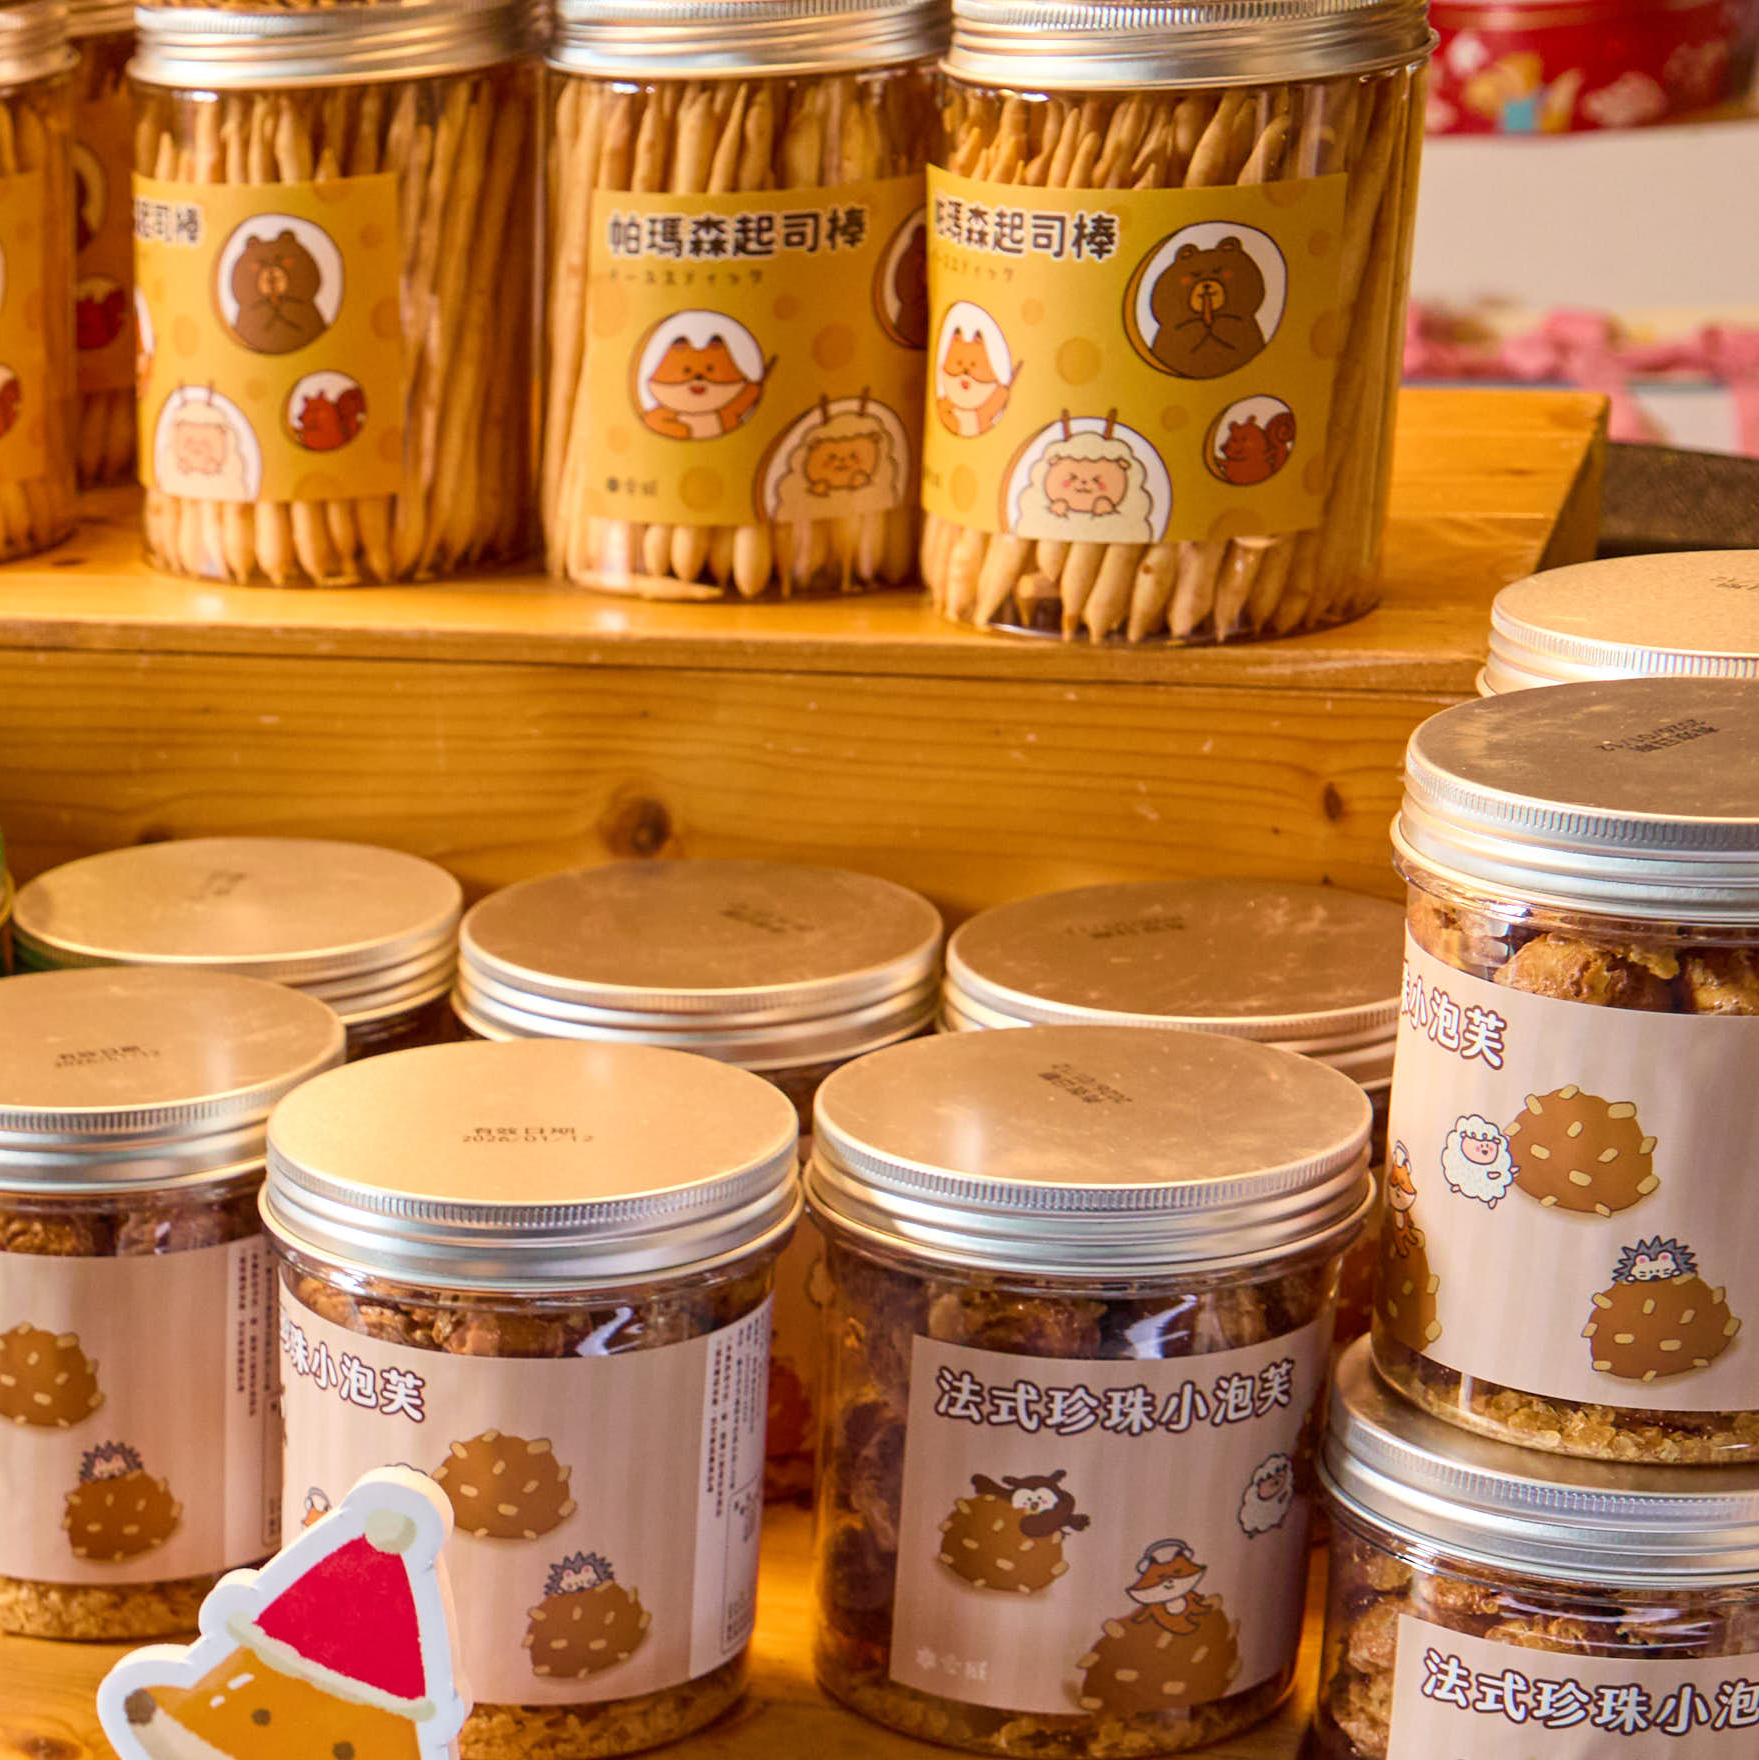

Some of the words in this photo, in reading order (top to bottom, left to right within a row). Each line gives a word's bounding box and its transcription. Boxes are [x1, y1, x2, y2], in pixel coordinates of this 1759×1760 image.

[608, 206, 868, 259] 帕瑪森起司棒
[935, 1358, 1295, 1437] 法式珍珠小泡芙
